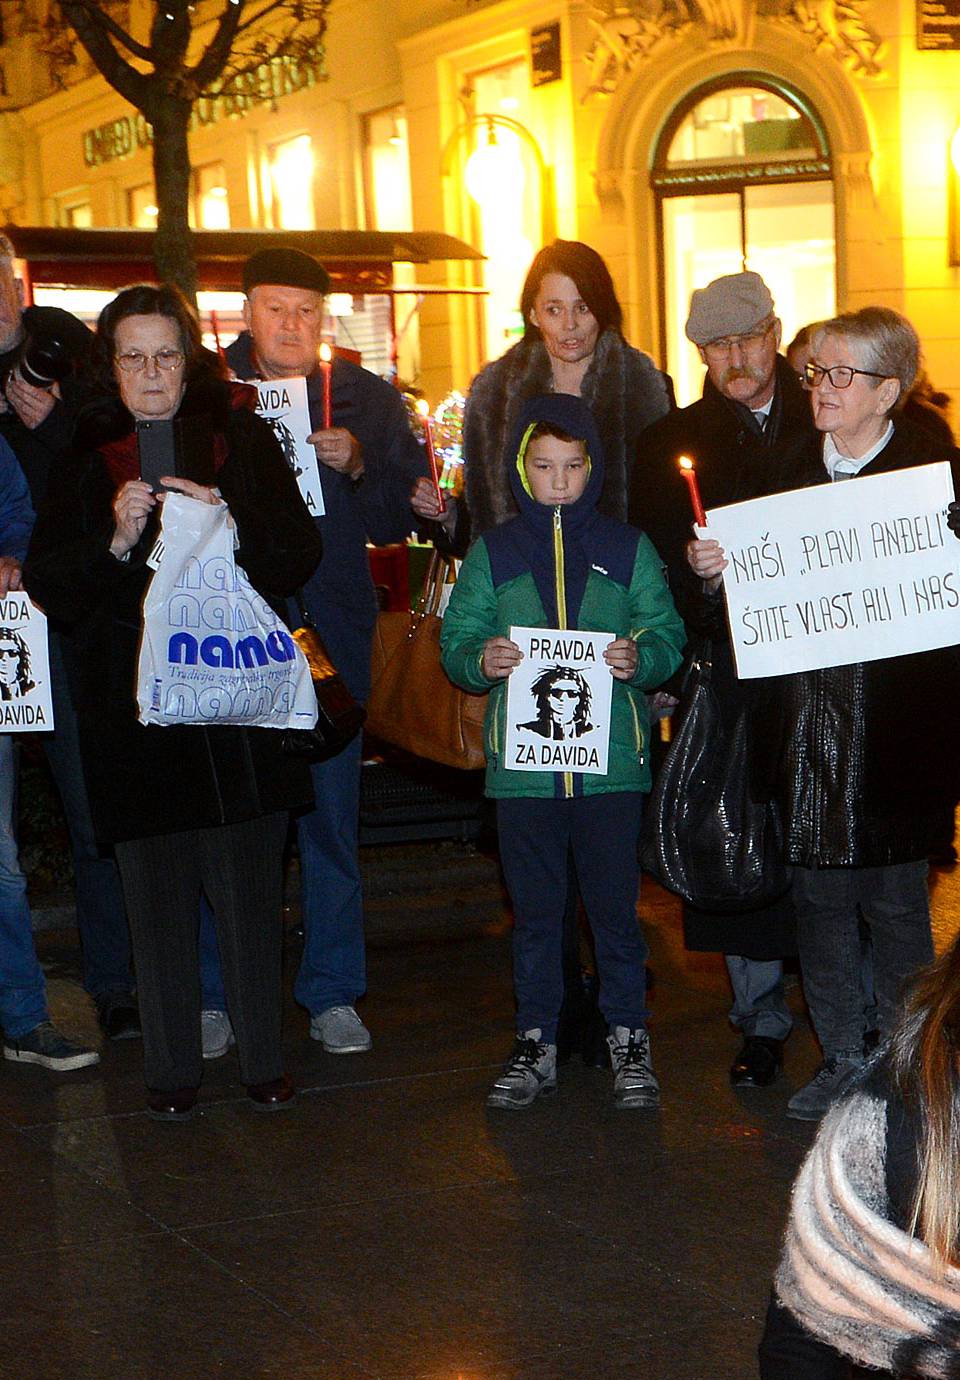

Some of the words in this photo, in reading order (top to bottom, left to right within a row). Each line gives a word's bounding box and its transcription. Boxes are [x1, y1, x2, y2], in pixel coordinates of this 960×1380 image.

[731, 531, 785, 584] NAŠI
[742, 604, 792, 646] ŠTITE
[862, 586, 892, 624] ALI
[899, 583, 908, 617] I
[530, 638, 596, 662] PRAVDA
[164, 680, 298, 718] nama
[515, 744, 537, 765] ZA
[541, 744, 600, 768] DAVIDA
